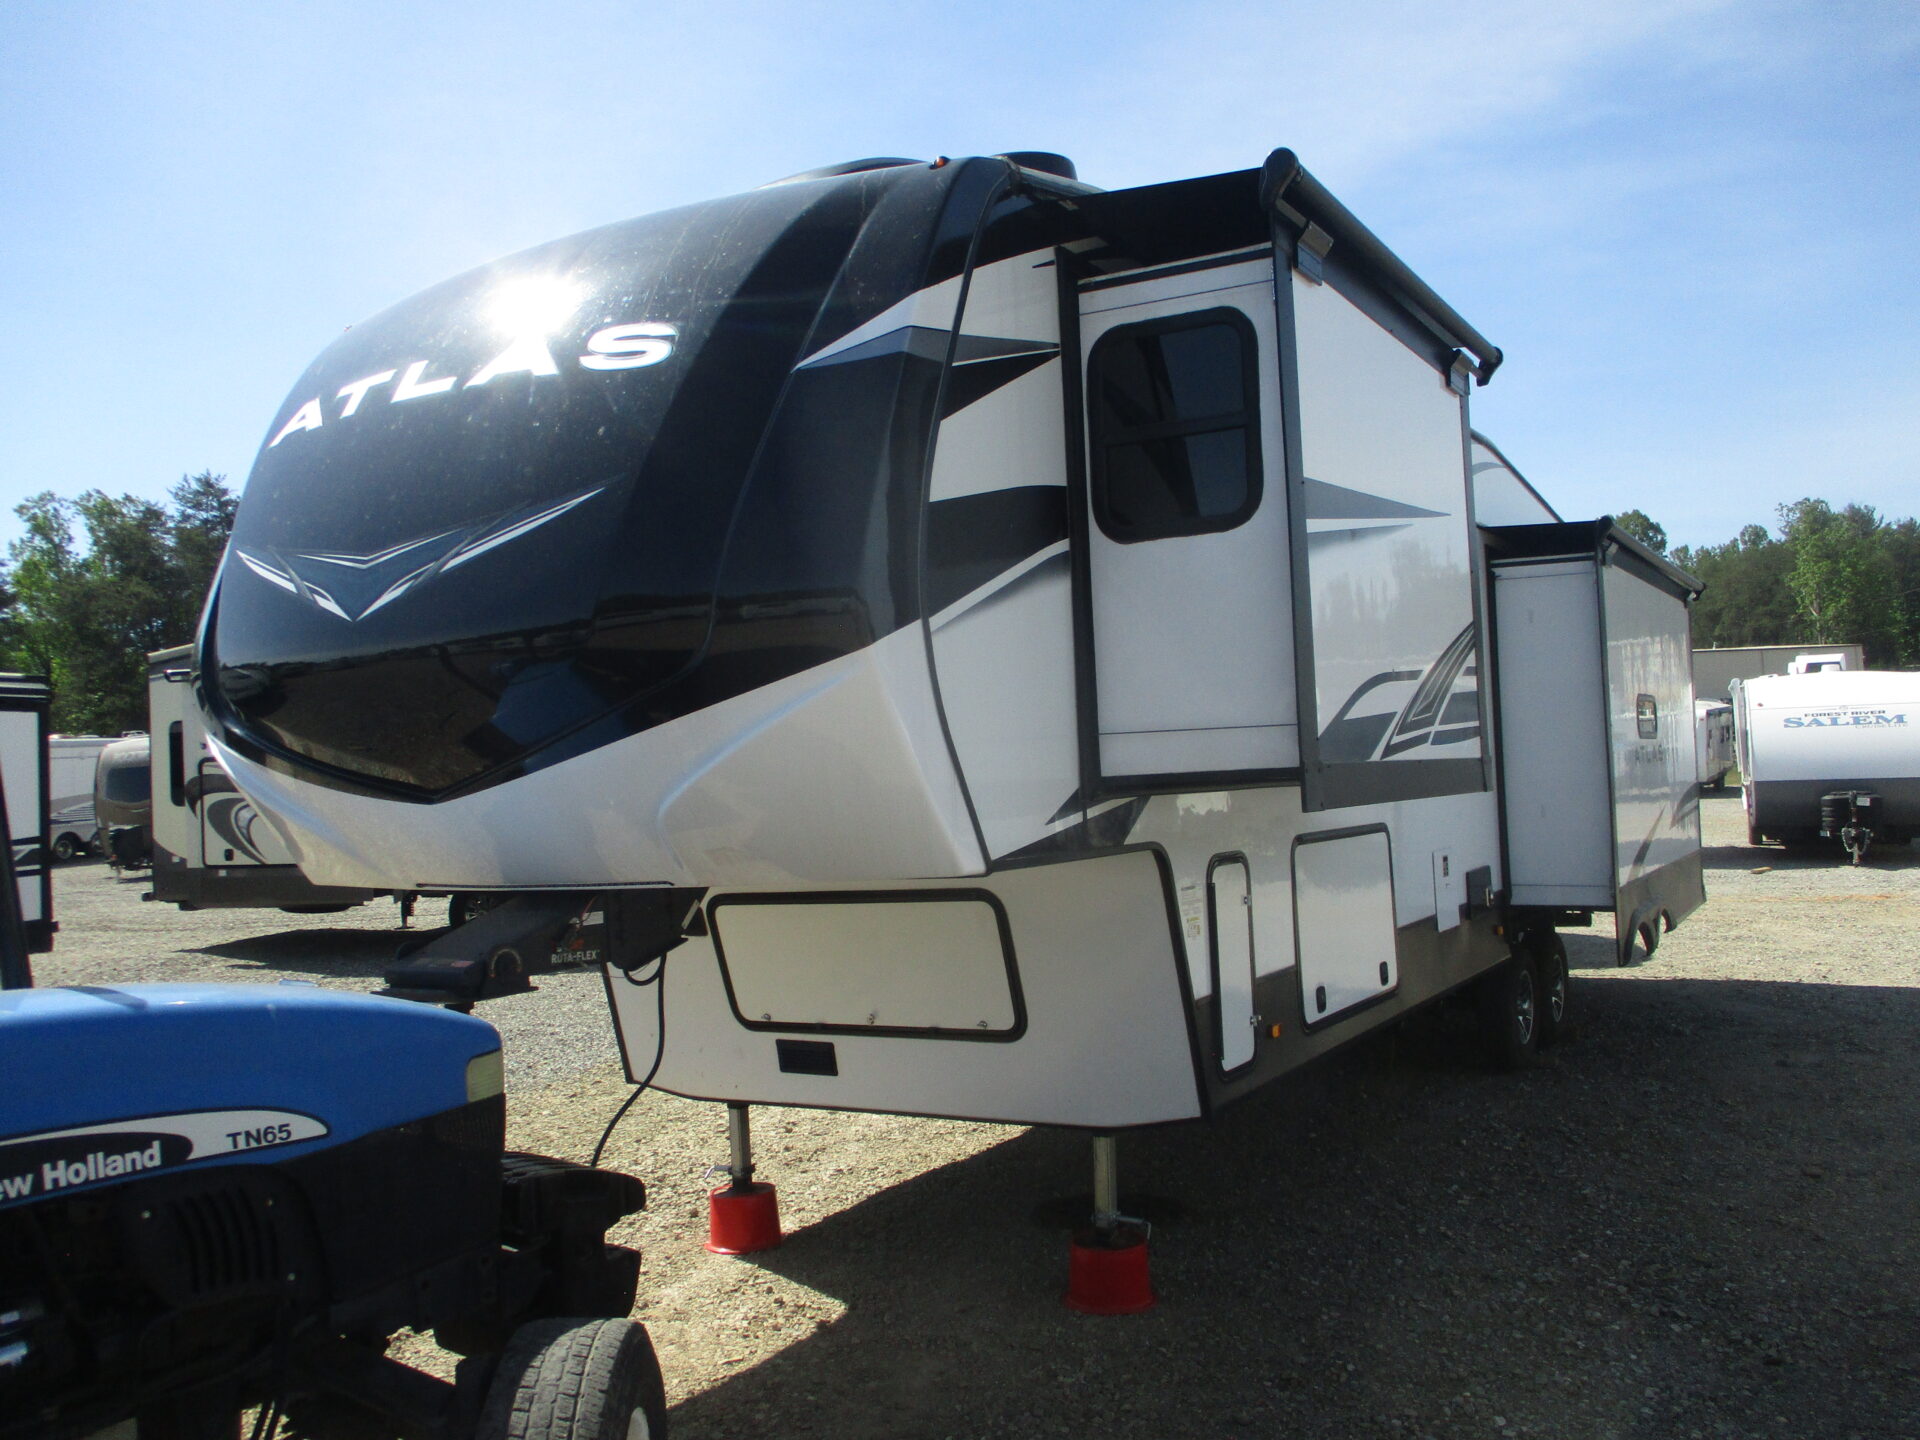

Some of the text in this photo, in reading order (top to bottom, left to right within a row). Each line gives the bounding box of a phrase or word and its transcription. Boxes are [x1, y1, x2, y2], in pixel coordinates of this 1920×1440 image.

[269, 321, 679, 448] ATLAS
[1783, 714, 1908, 729] SALEM
[226, 1123, 292, 1150] TN65
[42, 1140, 162, 1191] Holland
